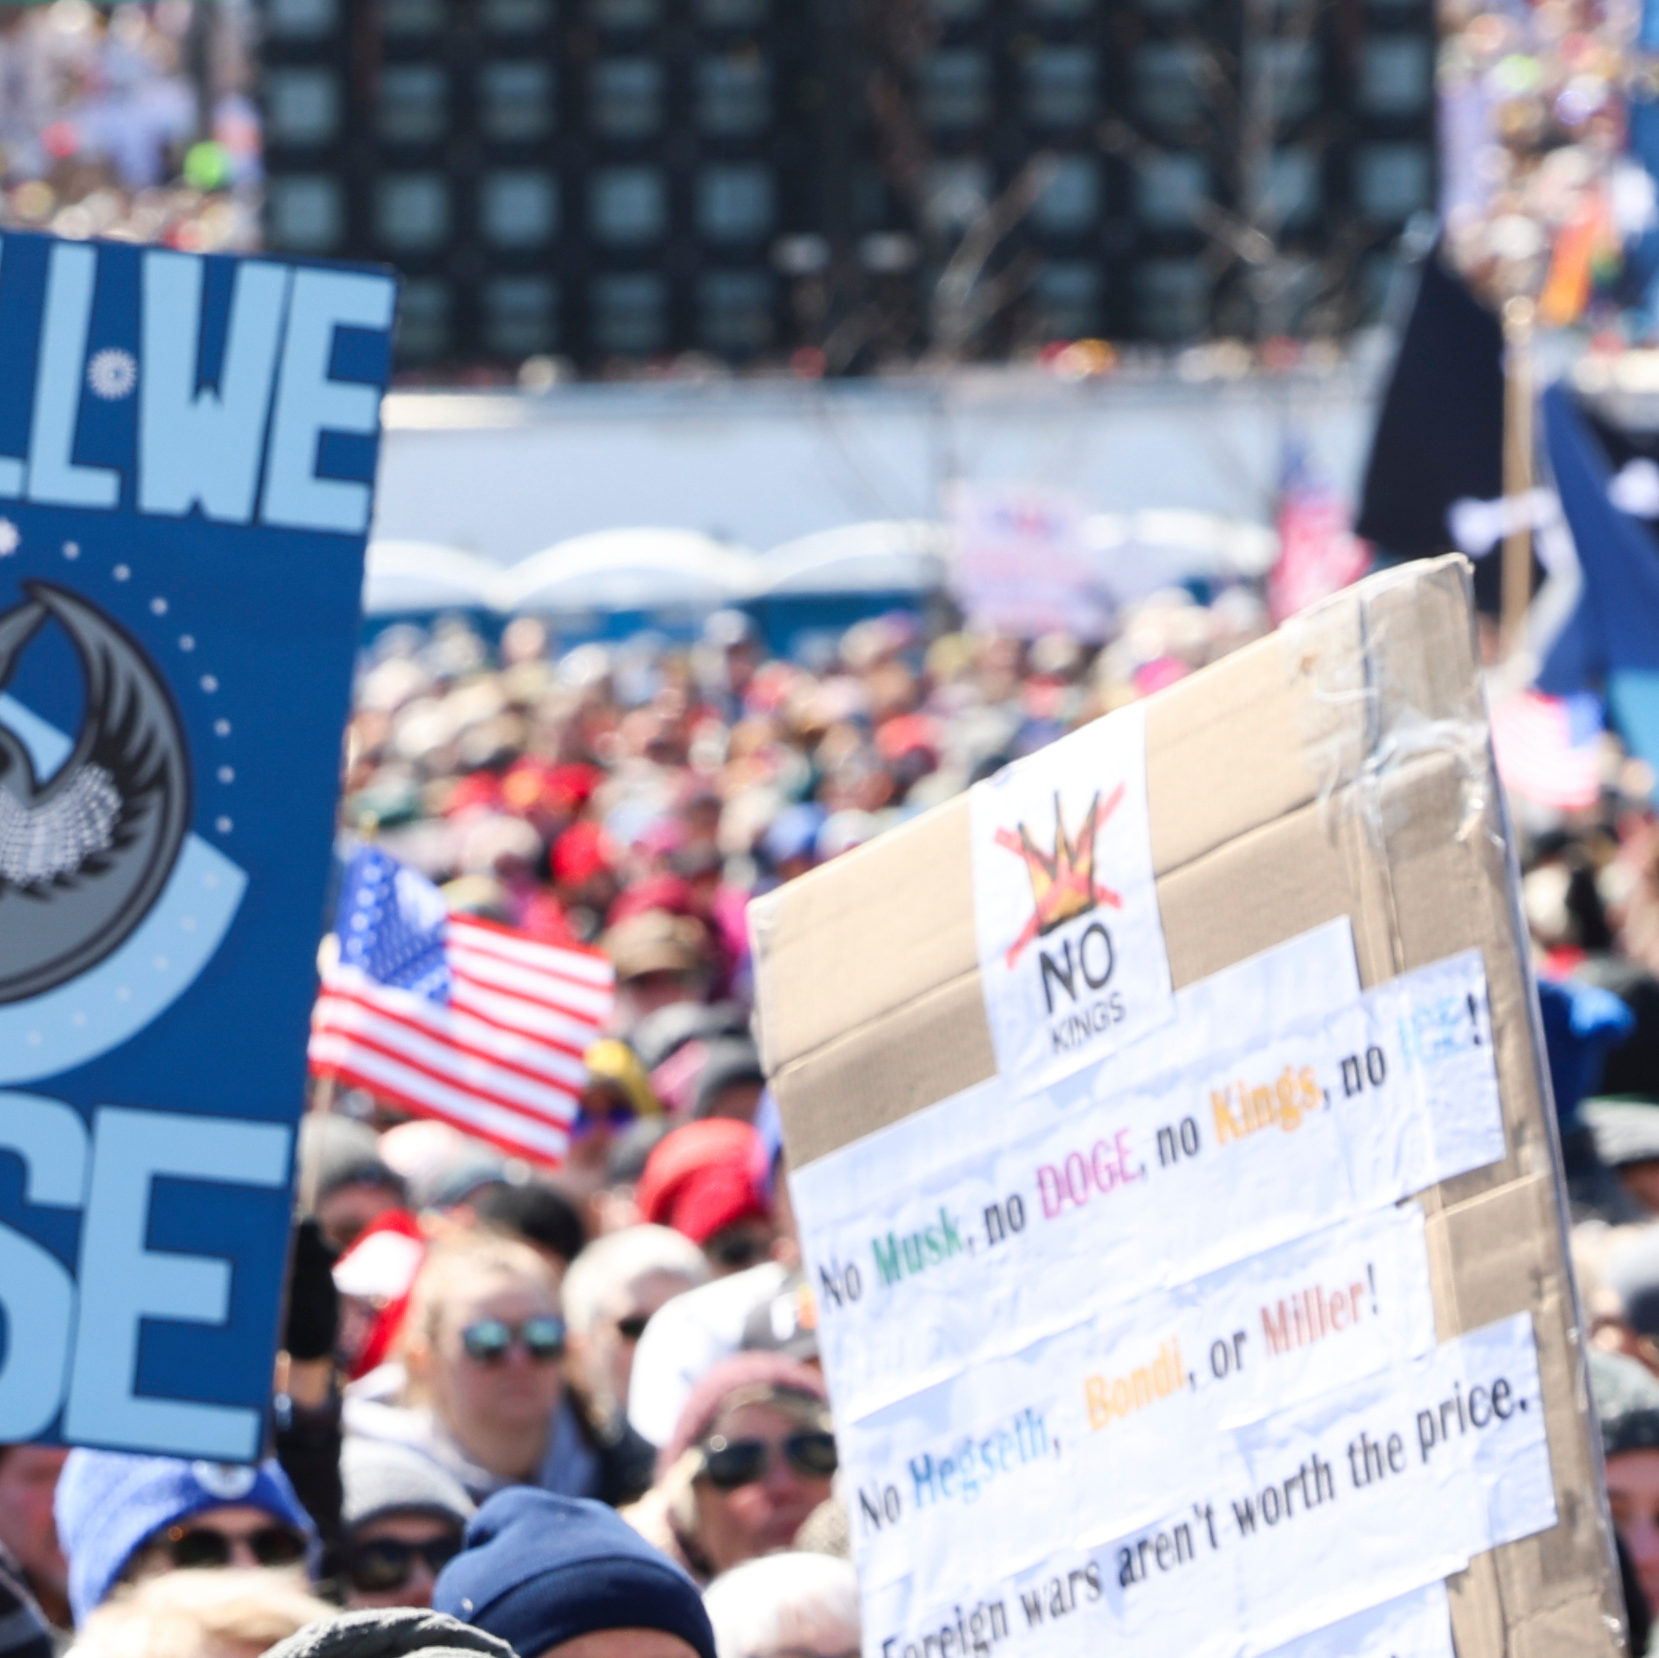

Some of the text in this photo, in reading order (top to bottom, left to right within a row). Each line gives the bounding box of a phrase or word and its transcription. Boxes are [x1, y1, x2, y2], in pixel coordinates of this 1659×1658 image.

[136, 249, 400, 536] WE
[1039, 922, 1114, 1014] NO
[1052, 991, 1126, 1054] KINGS
[818, 1256, 861, 1311] No
[872, 1206, 974, 1287] Musk,
[983, 1194, 1026, 1246] no
[1037, 1128, 1147, 1220] DOGE,
[1157, 1117, 1200, 1167] no
[1210, 1065, 1331, 1146] Kings,
[1341, 1044, 1386, 1098] no
[858, 1262, 1378, 1536] No Hegseth, Bondi, or Miller!
[1020, 1561, 1102, 1628] wars
[1118, 1501, 1219, 1588] aren't
[1232, 1452, 1336, 1537] worth
[1348, 1431, 1404, 1488] the
[1417, 1376, 1529, 1464] price.
